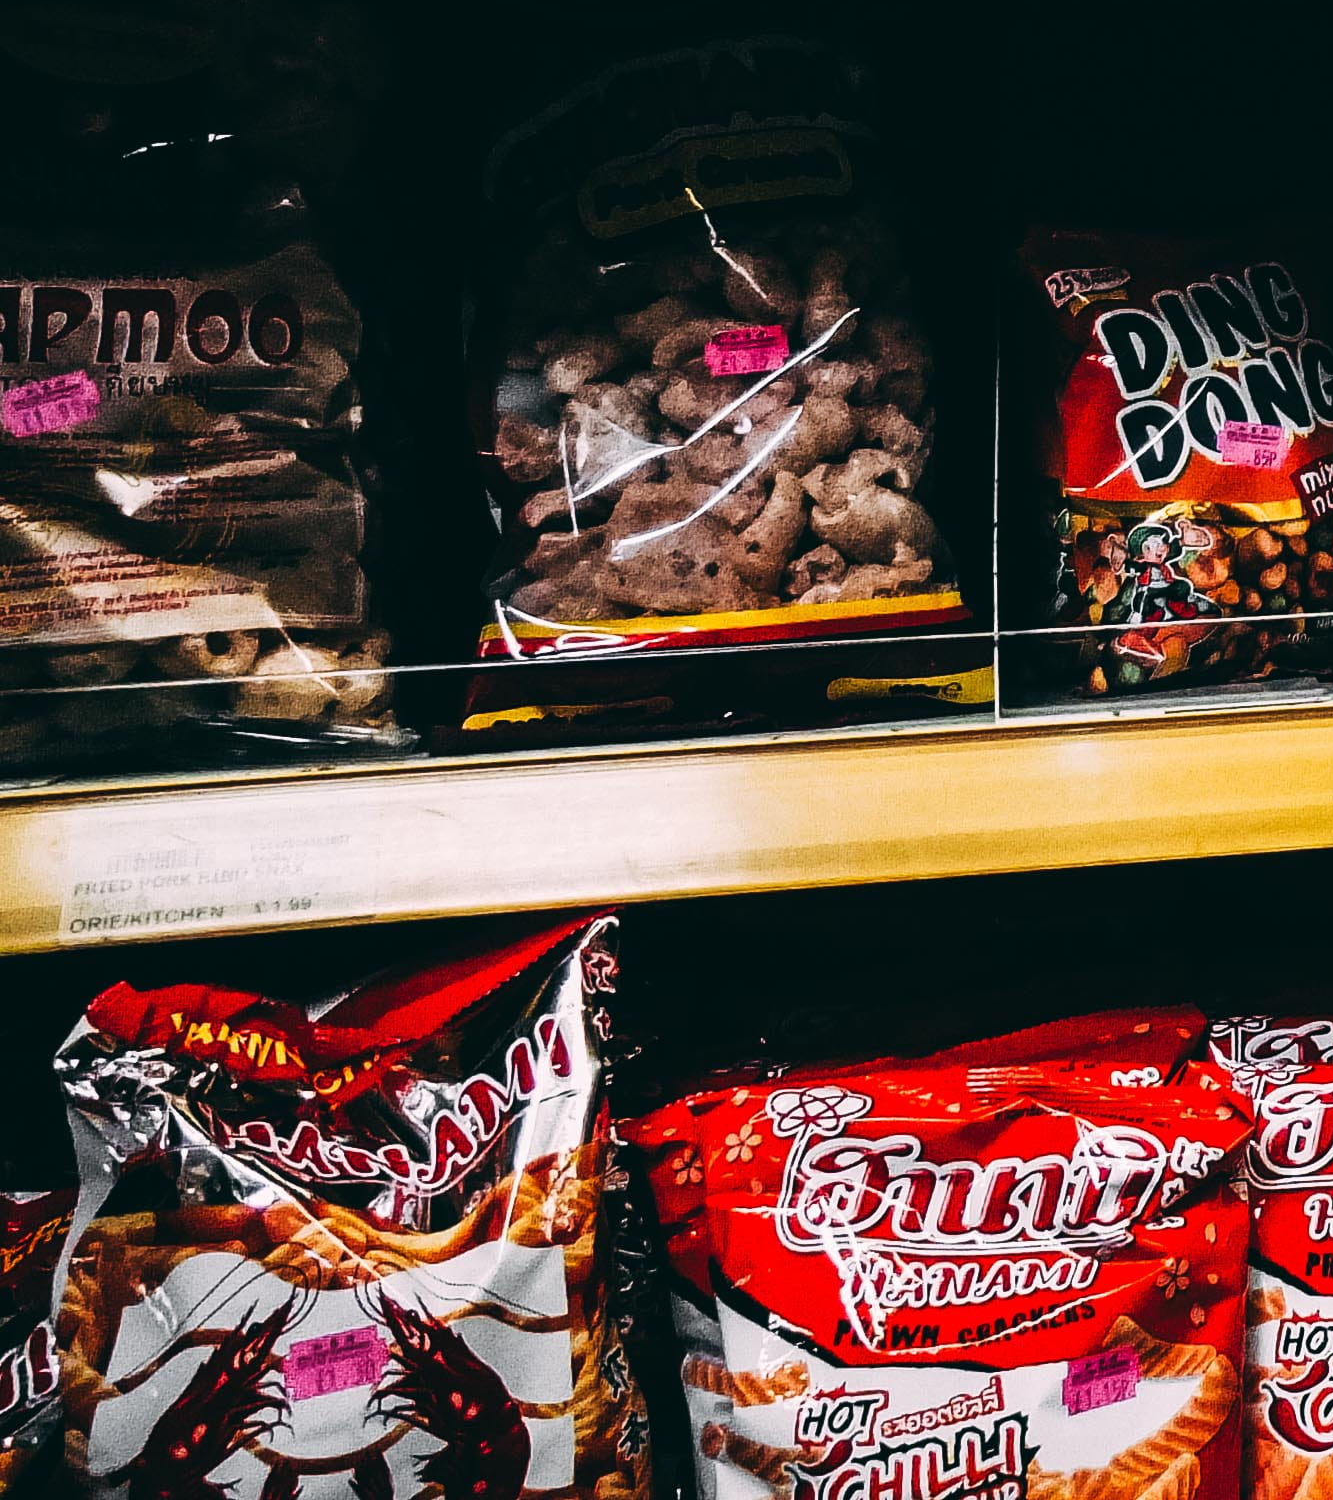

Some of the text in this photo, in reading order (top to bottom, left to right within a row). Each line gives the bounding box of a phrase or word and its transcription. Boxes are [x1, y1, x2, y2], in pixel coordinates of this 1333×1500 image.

[1096, 261, 1309, 398] DING
[69, 905, 226, 935] ORIE/KITCHEN
[798, 1396, 884, 1440] HOT
[825, 1413, 1030, 1500] CHILLI
